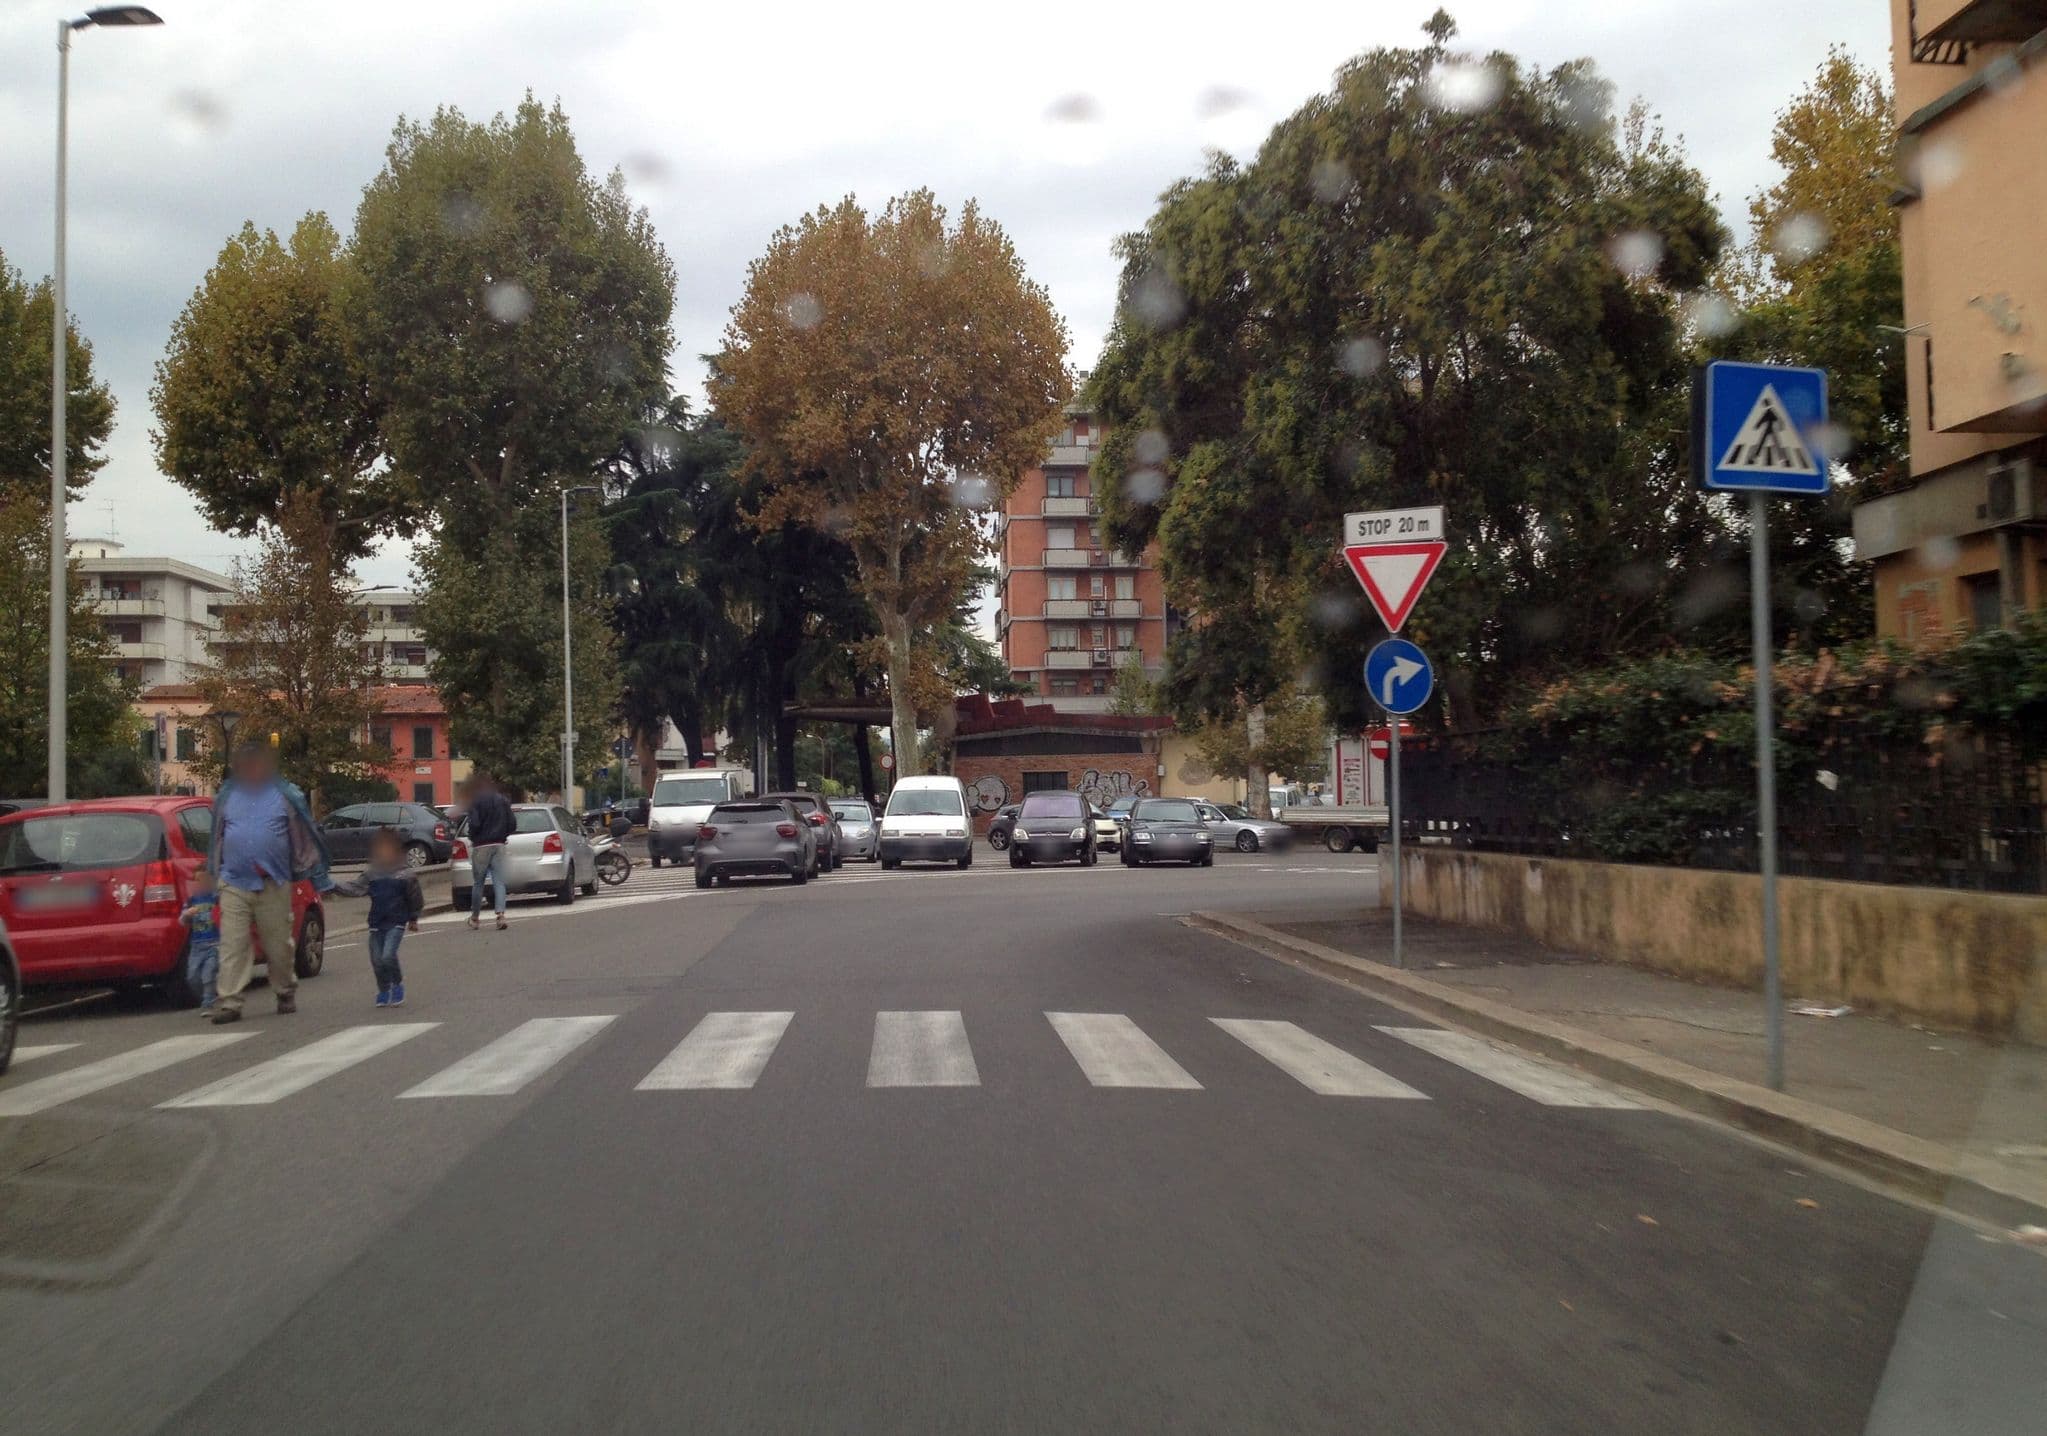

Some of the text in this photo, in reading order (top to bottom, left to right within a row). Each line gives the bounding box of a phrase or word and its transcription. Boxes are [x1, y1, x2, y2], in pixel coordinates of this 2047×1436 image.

[1358, 517, 1430, 536] STOP 20 m
